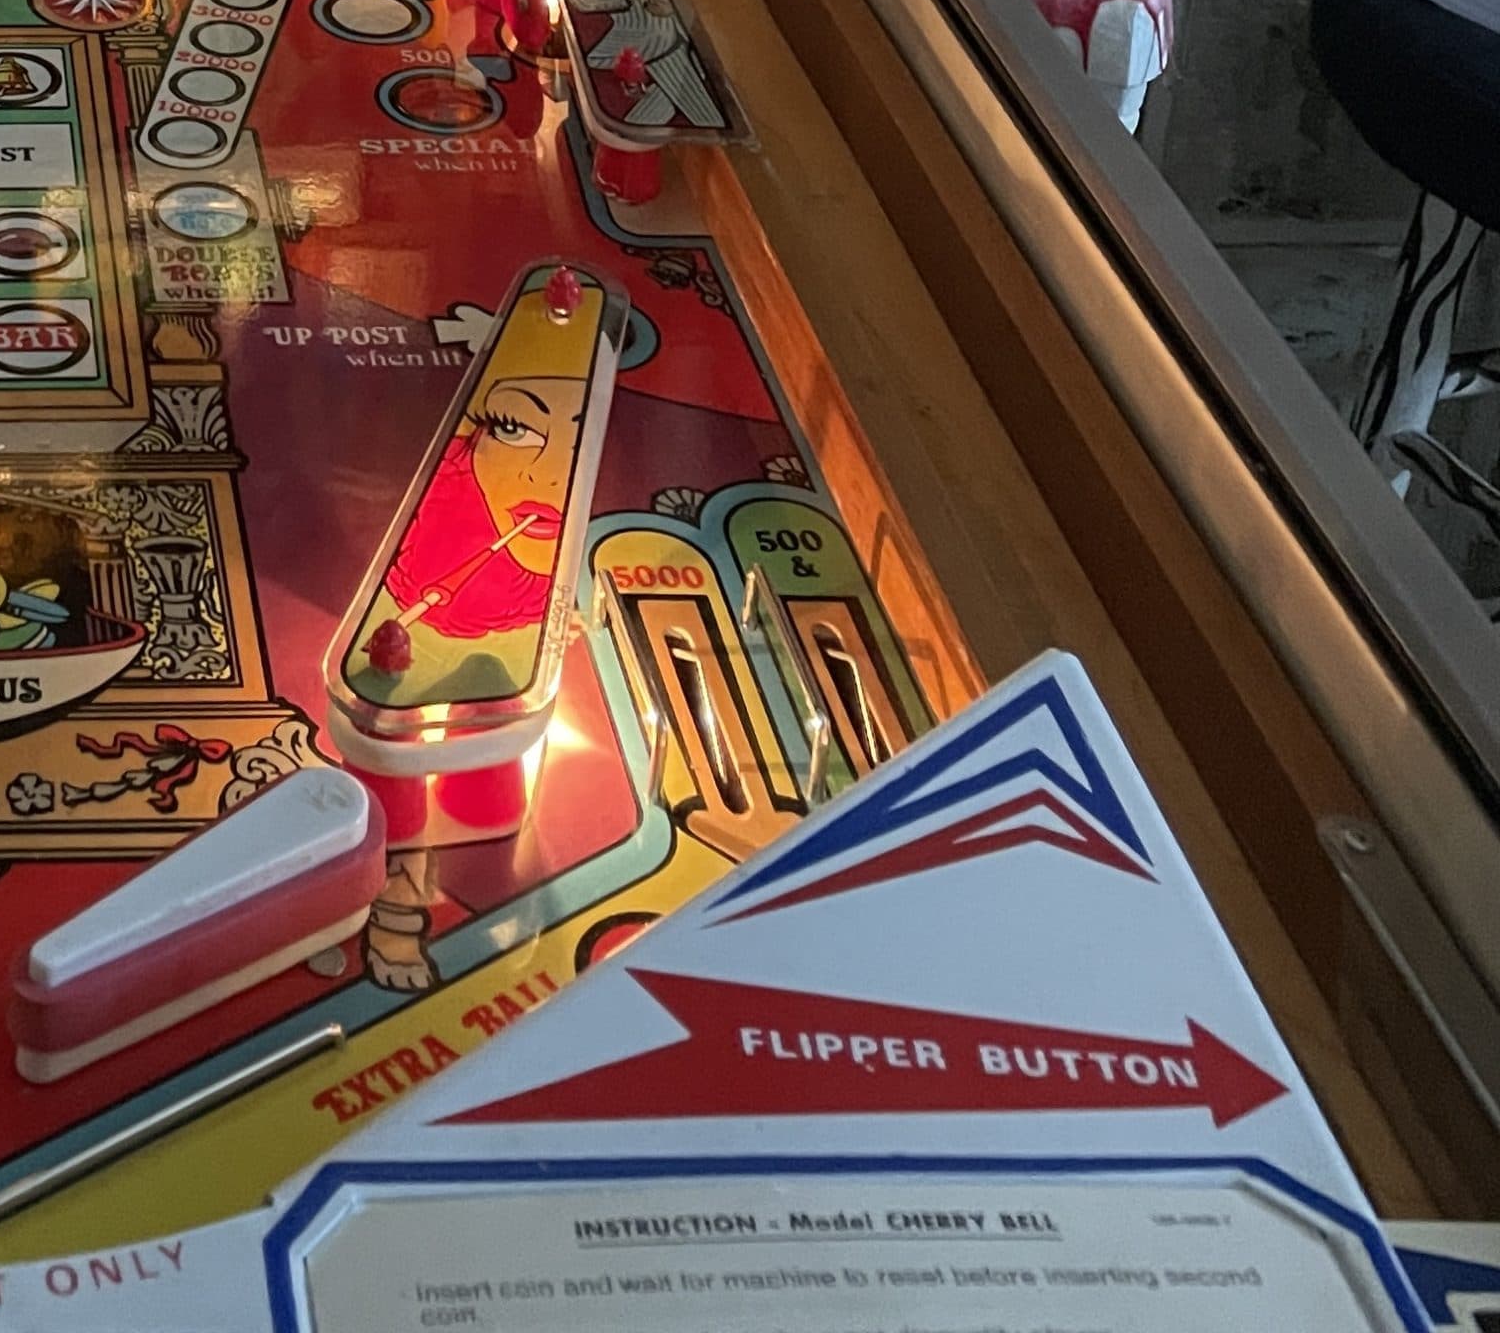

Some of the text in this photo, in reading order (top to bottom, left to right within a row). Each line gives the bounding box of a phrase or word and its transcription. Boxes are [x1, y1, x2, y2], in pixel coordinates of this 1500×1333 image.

[191, 4, 275, 27] 30000
[174, 49, 258, 73] 20000
[400, 49, 452, 65] 500
[155, 99, 238, 124] 10000
[358, 138, 537, 155] SPECIAL
[262, 325, 408, 346] UP POST
[345, 349, 463, 367] when lit
[755, 528, 823, 553] 500
[611, 564, 704, 590] 5000
[791, 553, 822, 578] &
[739, 1027, 1202, 1089] FLIPPER BUTTON
[311, 1033, 461, 1125] EXTRA
[574, 1211, 1060, 1241] INSTRUCTION Model CHERRY BELL
[43, 1240, 188, 1298] ONLY
[563, 1275, 613, 1296] and
[618, 1272, 671, 1294] wait
[722, 1268, 837, 1291] machine
[1163, 1266, 1263, 1287] second
